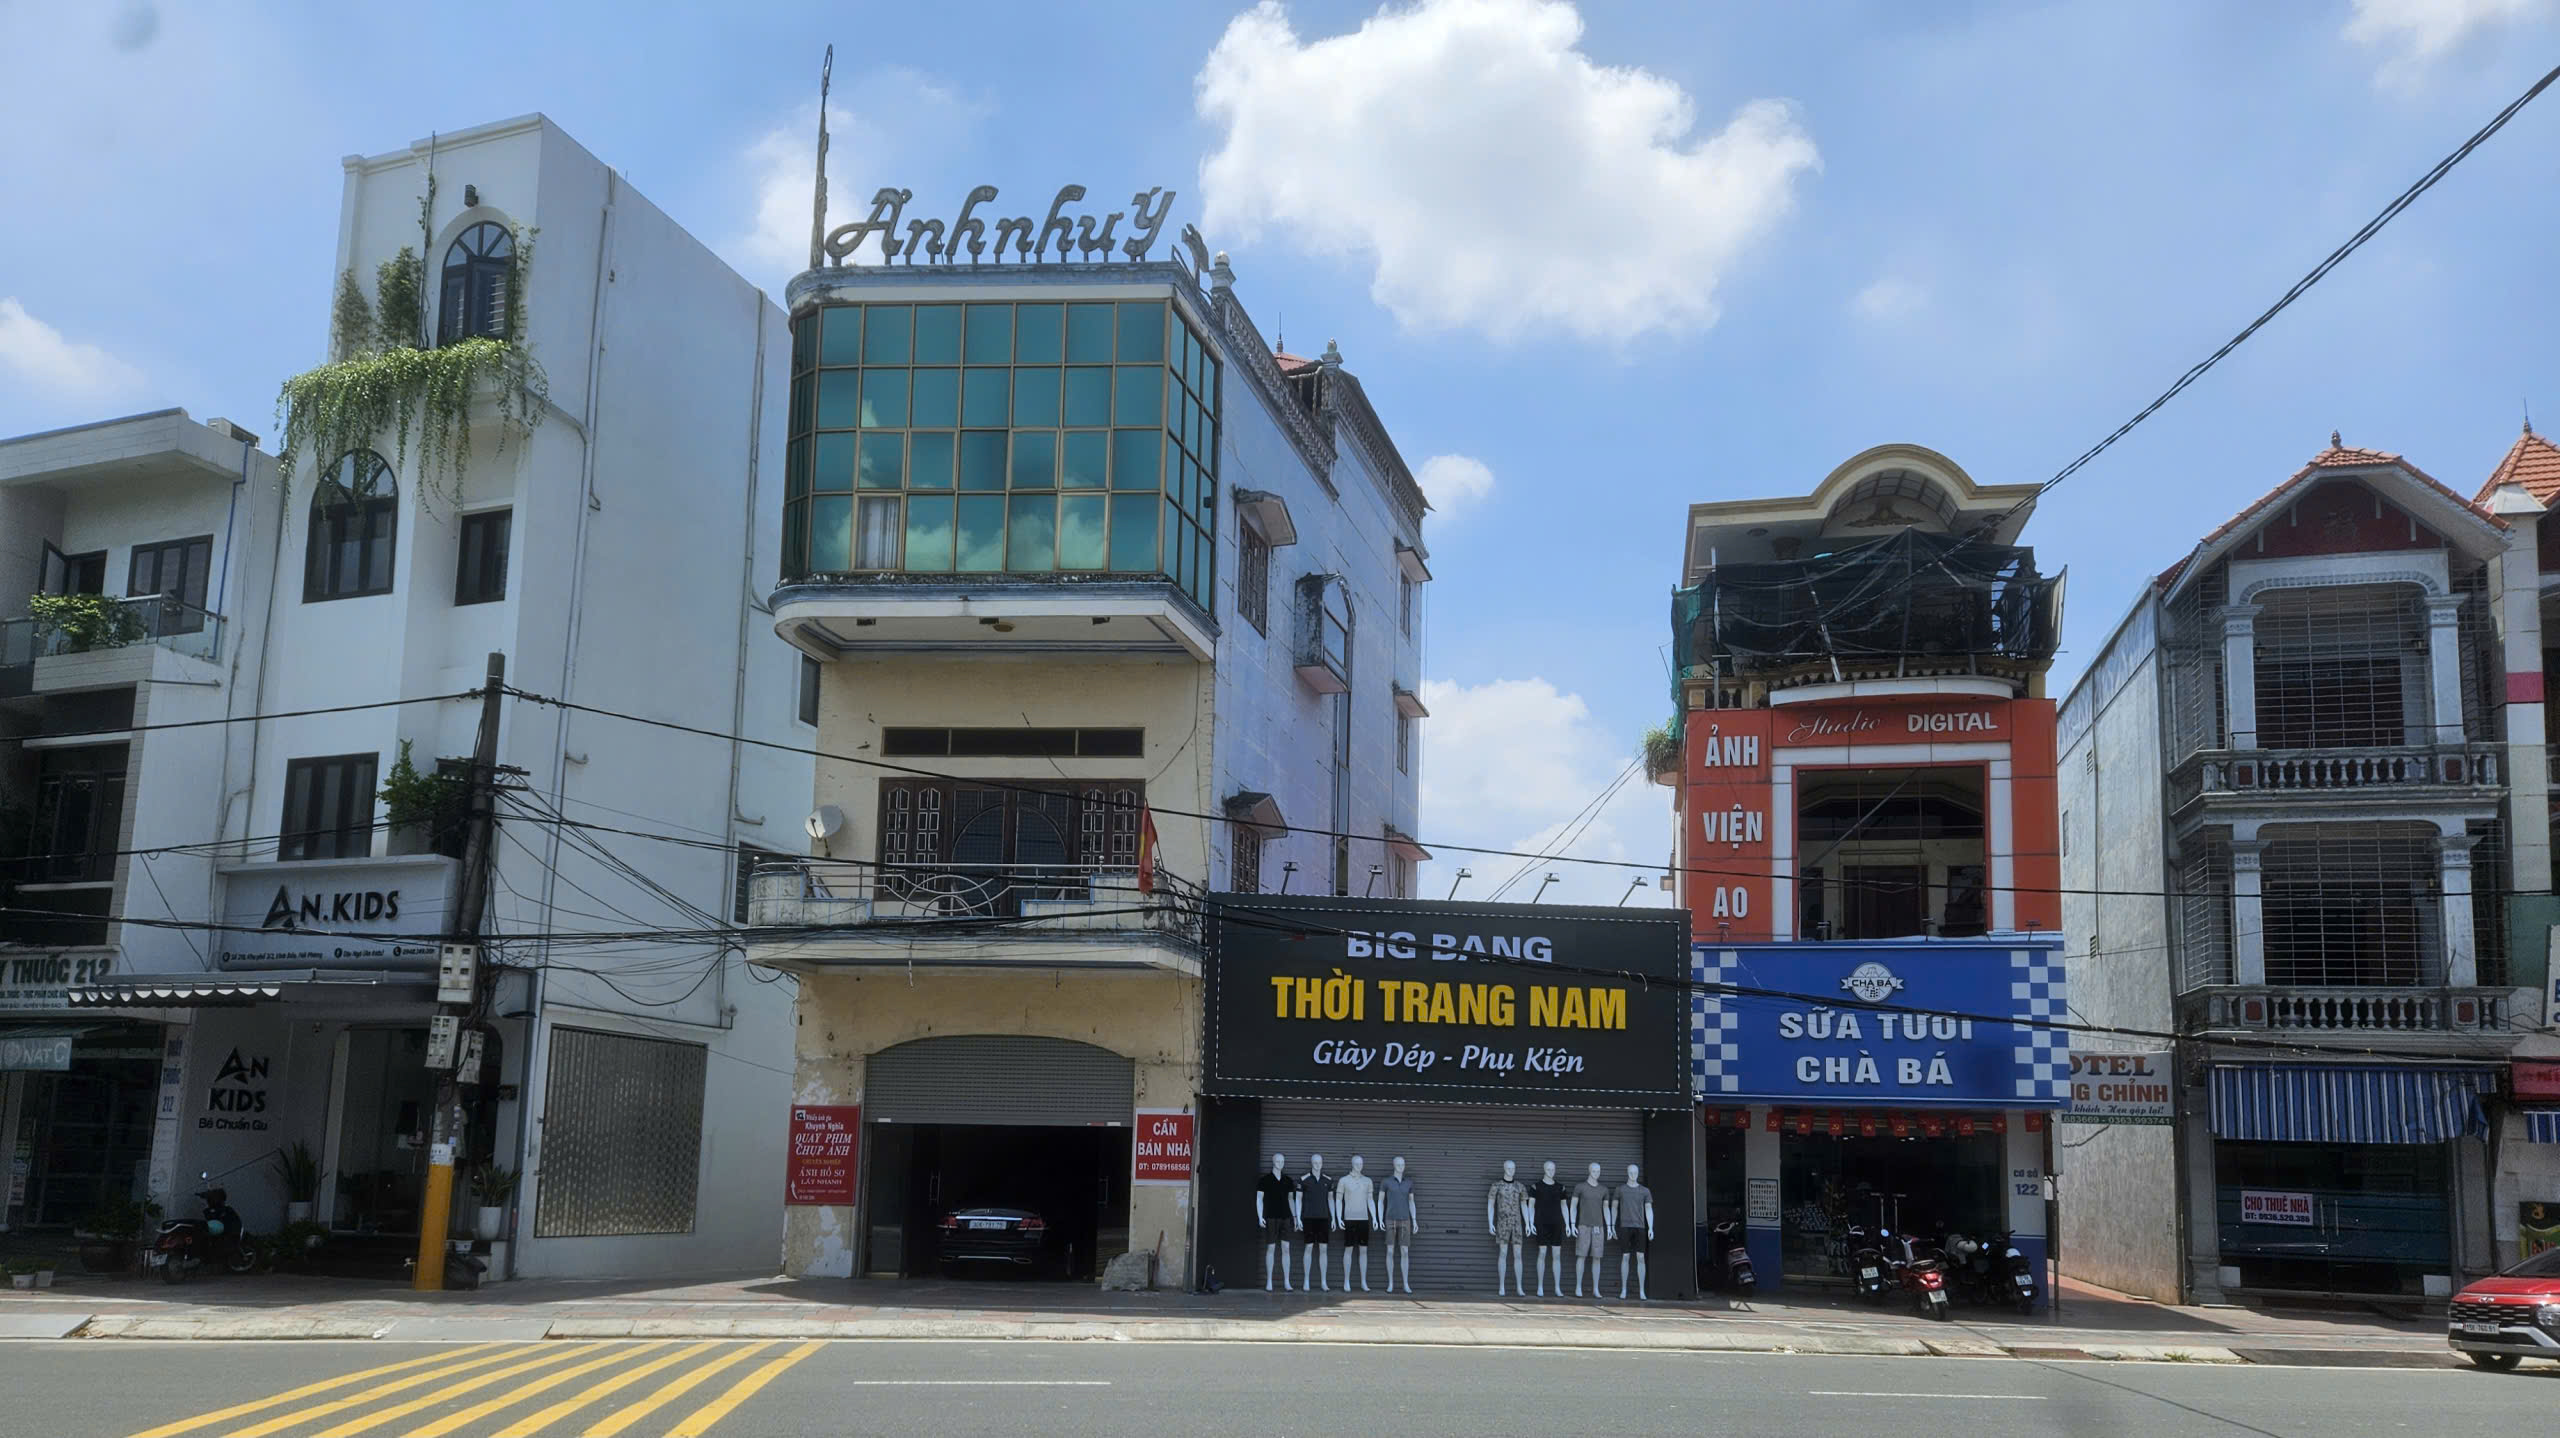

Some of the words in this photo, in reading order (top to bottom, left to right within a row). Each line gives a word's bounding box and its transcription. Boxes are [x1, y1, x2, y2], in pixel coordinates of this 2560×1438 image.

[1788, 710, 1881, 743] Studio
[1907, 712, 1999, 732] DIGITAL
[1705, 724, 1759, 767] ẢNH
[1702, 803, 1763, 849] VIỆN
[262, 885, 399, 929] AN.KIDS
[1347, 931, 1416, 960] BIG
[1432, 934, 1553, 964] BANG
[12, 954, 71, 984] THUỐC
[74, 958, 111, 984] 212
[1270, 967, 1365, 1022] THỜI
[1378, 980, 1515, 1026] TRANG
[1530, 986, 1627, 1030] NAM
[1780, 1006, 1863, 1040] SỮA
[214, 1046, 270, 1084] AN
[1313, 1040, 1376, 1072] Giày
[1383, 1042, 1436, 1073] Dép
[1460, 1044, 1515, 1078] Phụ
[1524, 1047, 1585, 1079] Kiện
[1796, 1050, 1881, 1084] CHÀ
[1897, 1050, 1954, 1085] BÁ
[2069, 1055, 2155, 1076] OTEL
[208, 1088, 266, 1112] KIDS
[2098, 1078, 2168, 1102] CHỈNH
[2063, 1115, 2099, 1123] 683669
[795, 1133, 822, 1145] QUAY
[825, 1133, 853, 1144] PHIM
[796, 1144, 824, 1157] CHỤP
[1137, 1138, 1162, 1156] BÁN
[1166, 1139, 1191, 1156] NHÀ
[2015, 1183, 2039, 1196] 122
[2244, 1196, 2262, 1210] CHO
[2264, 1195, 2289, 1212] THUÊ
[2290, 1196, 2309, 1213] NHÀ
